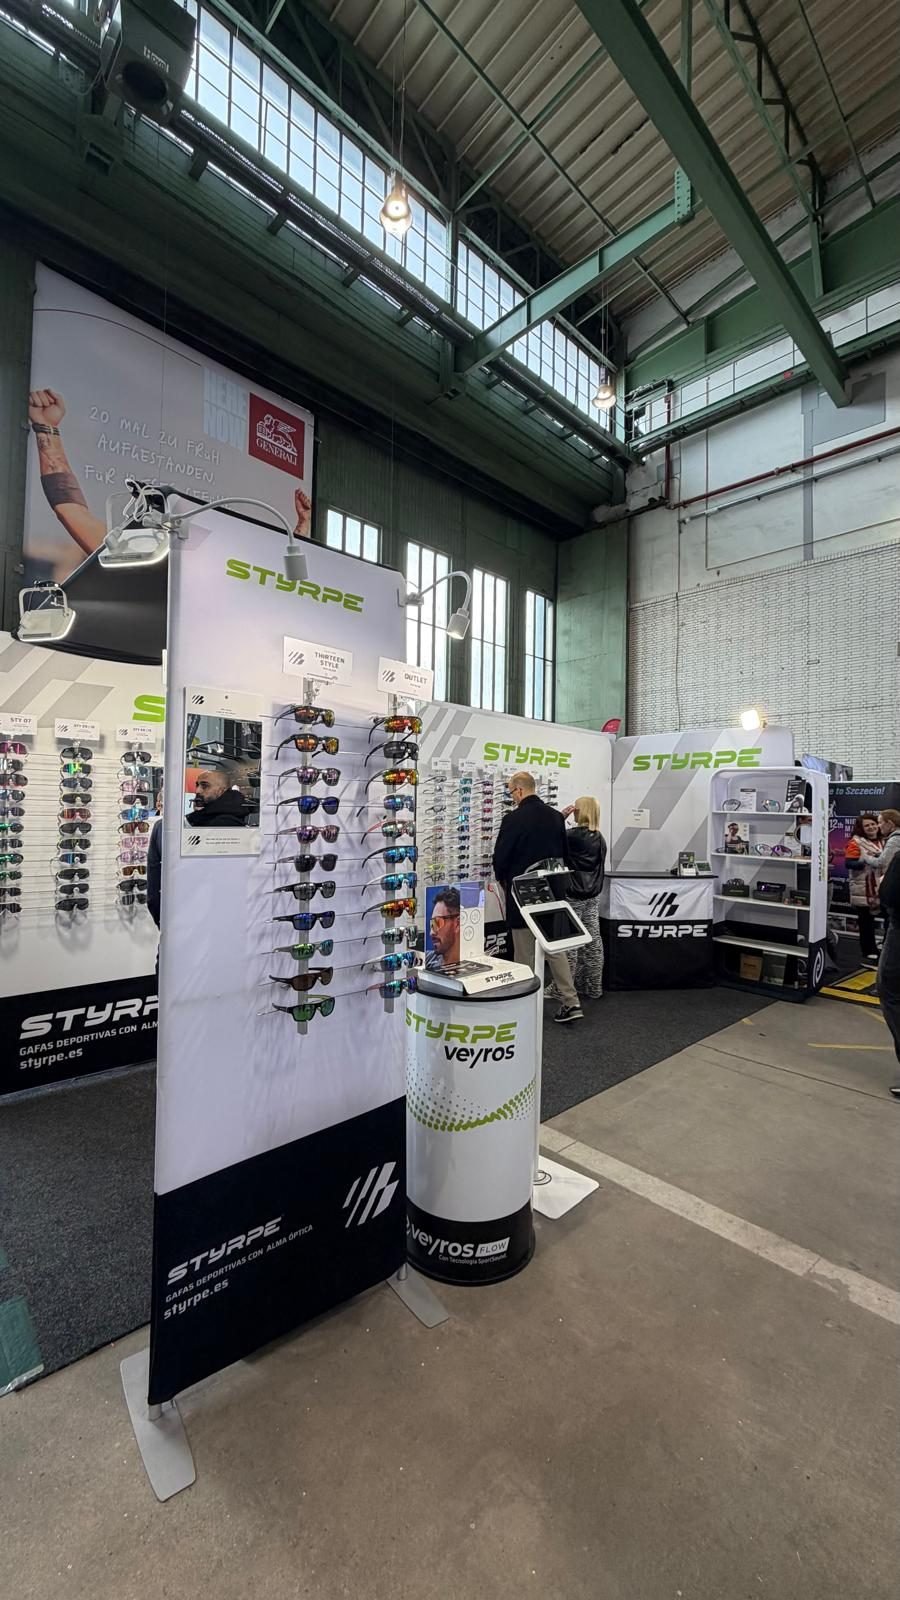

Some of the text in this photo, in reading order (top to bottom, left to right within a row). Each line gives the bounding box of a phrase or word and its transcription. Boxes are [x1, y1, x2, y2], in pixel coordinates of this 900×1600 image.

[88, 406, 110, 424] 20
[120, 418, 150, 439] MAL
[159, 431, 178, 449] ZU
[256, 438, 297, 466] GENERALI
[225, 558, 364, 613] STYRPE
[314, 651, 345, 664] THIRTEEN
[320, 659, 340, 670] STYLE
[404, 673, 428, 684] OUTLET
[483, 742, 572, 769] STYRPE
[632, 747, 763, 771] STYRPE
[836, 787, 844, 795] to
[845, 786, 886, 796] Szczecin!
[617, 924, 709, 938] STYRPE
[19, 1041, 54, 1056] GAFAS
[56, 1029, 117, 1048] DEPORTIVAS
[118, 1024, 137, 1035] CON
[19, 1047, 83, 1070] styrpe.es
[444, 1044, 515, 1069] veyros
[167, 1216, 282, 1286] STYRPE
[411, 1223, 507, 1258] veyros FLOW
[165, 1224, 313, 1303] GAFAS DEPORTIVAS CON ALMA ÓPTICA
[163, 1278, 230, 1320] styrpe.es
